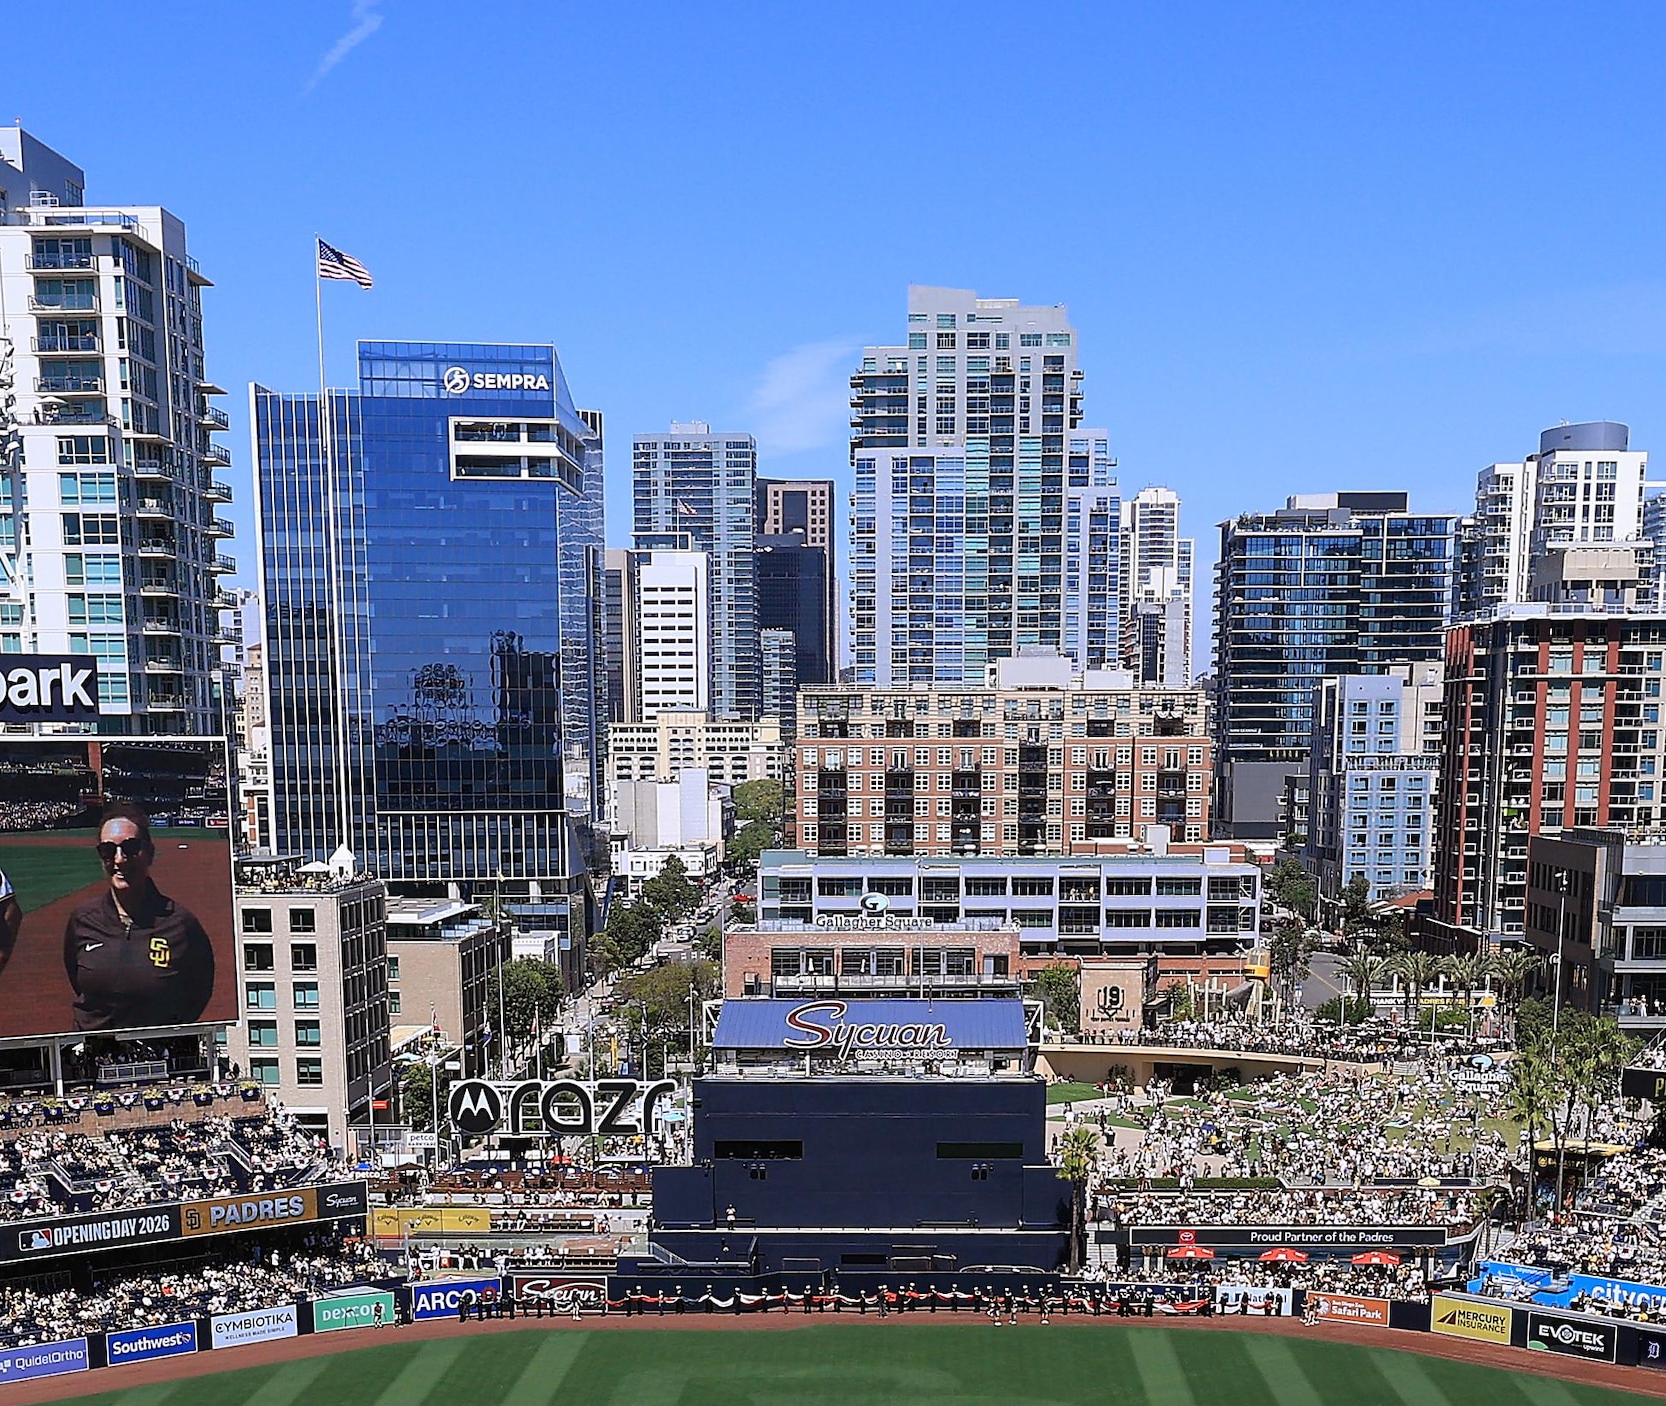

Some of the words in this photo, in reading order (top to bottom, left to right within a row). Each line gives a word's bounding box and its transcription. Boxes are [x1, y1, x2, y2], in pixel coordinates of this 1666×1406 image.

[474, 376, 550, 391] SEMPRA
[816, 916, 884, 931] Gallagher
[885, 916, 933, 931] Square
[1102, 986, 1121, 1006] 19
[783, 1000, 952, 1060] Sycuan
[1448, 1070, 1510, 1084] Gallagher
[1456, 1081, 1501, 1093] Square
[508, 1080, 678, 1134] razr
[36, 1115, 80, 1129] LANDING
[410, 1135, 435, 1143] petco
[211, 1197, 303, 1227] PADRES
[54, 1222, 110, 1247] OPENING
[110, 1218, 136, 1241] DAY
[137, 1213, 170, 1236] 2026
[1250, 1230, 1282, 1245] Proud
[1284, 1231, 1323, 1245] Partner
[1325, 1231, 1337, 1245] of
[1337, 1231, 1356, 1245] the
[1357, 1230, 1394, 1245] Padres
[1331, 1306, 1358, 1319] Safari
[1359, 1308, 1383, 1321] Park
[1457, 1309, 1506, 1324] MERCURY
[215, 1312, 294, 1338] CYMBIOTIKA
[1457, 1319, 1506, 1334] INSURANCE
[1538, 1323, 1605, 1345] EVOTEK
[111, 1332, 183, 1355] Southwest
[15, 1350, 84, 1370] QuidelOrtho
